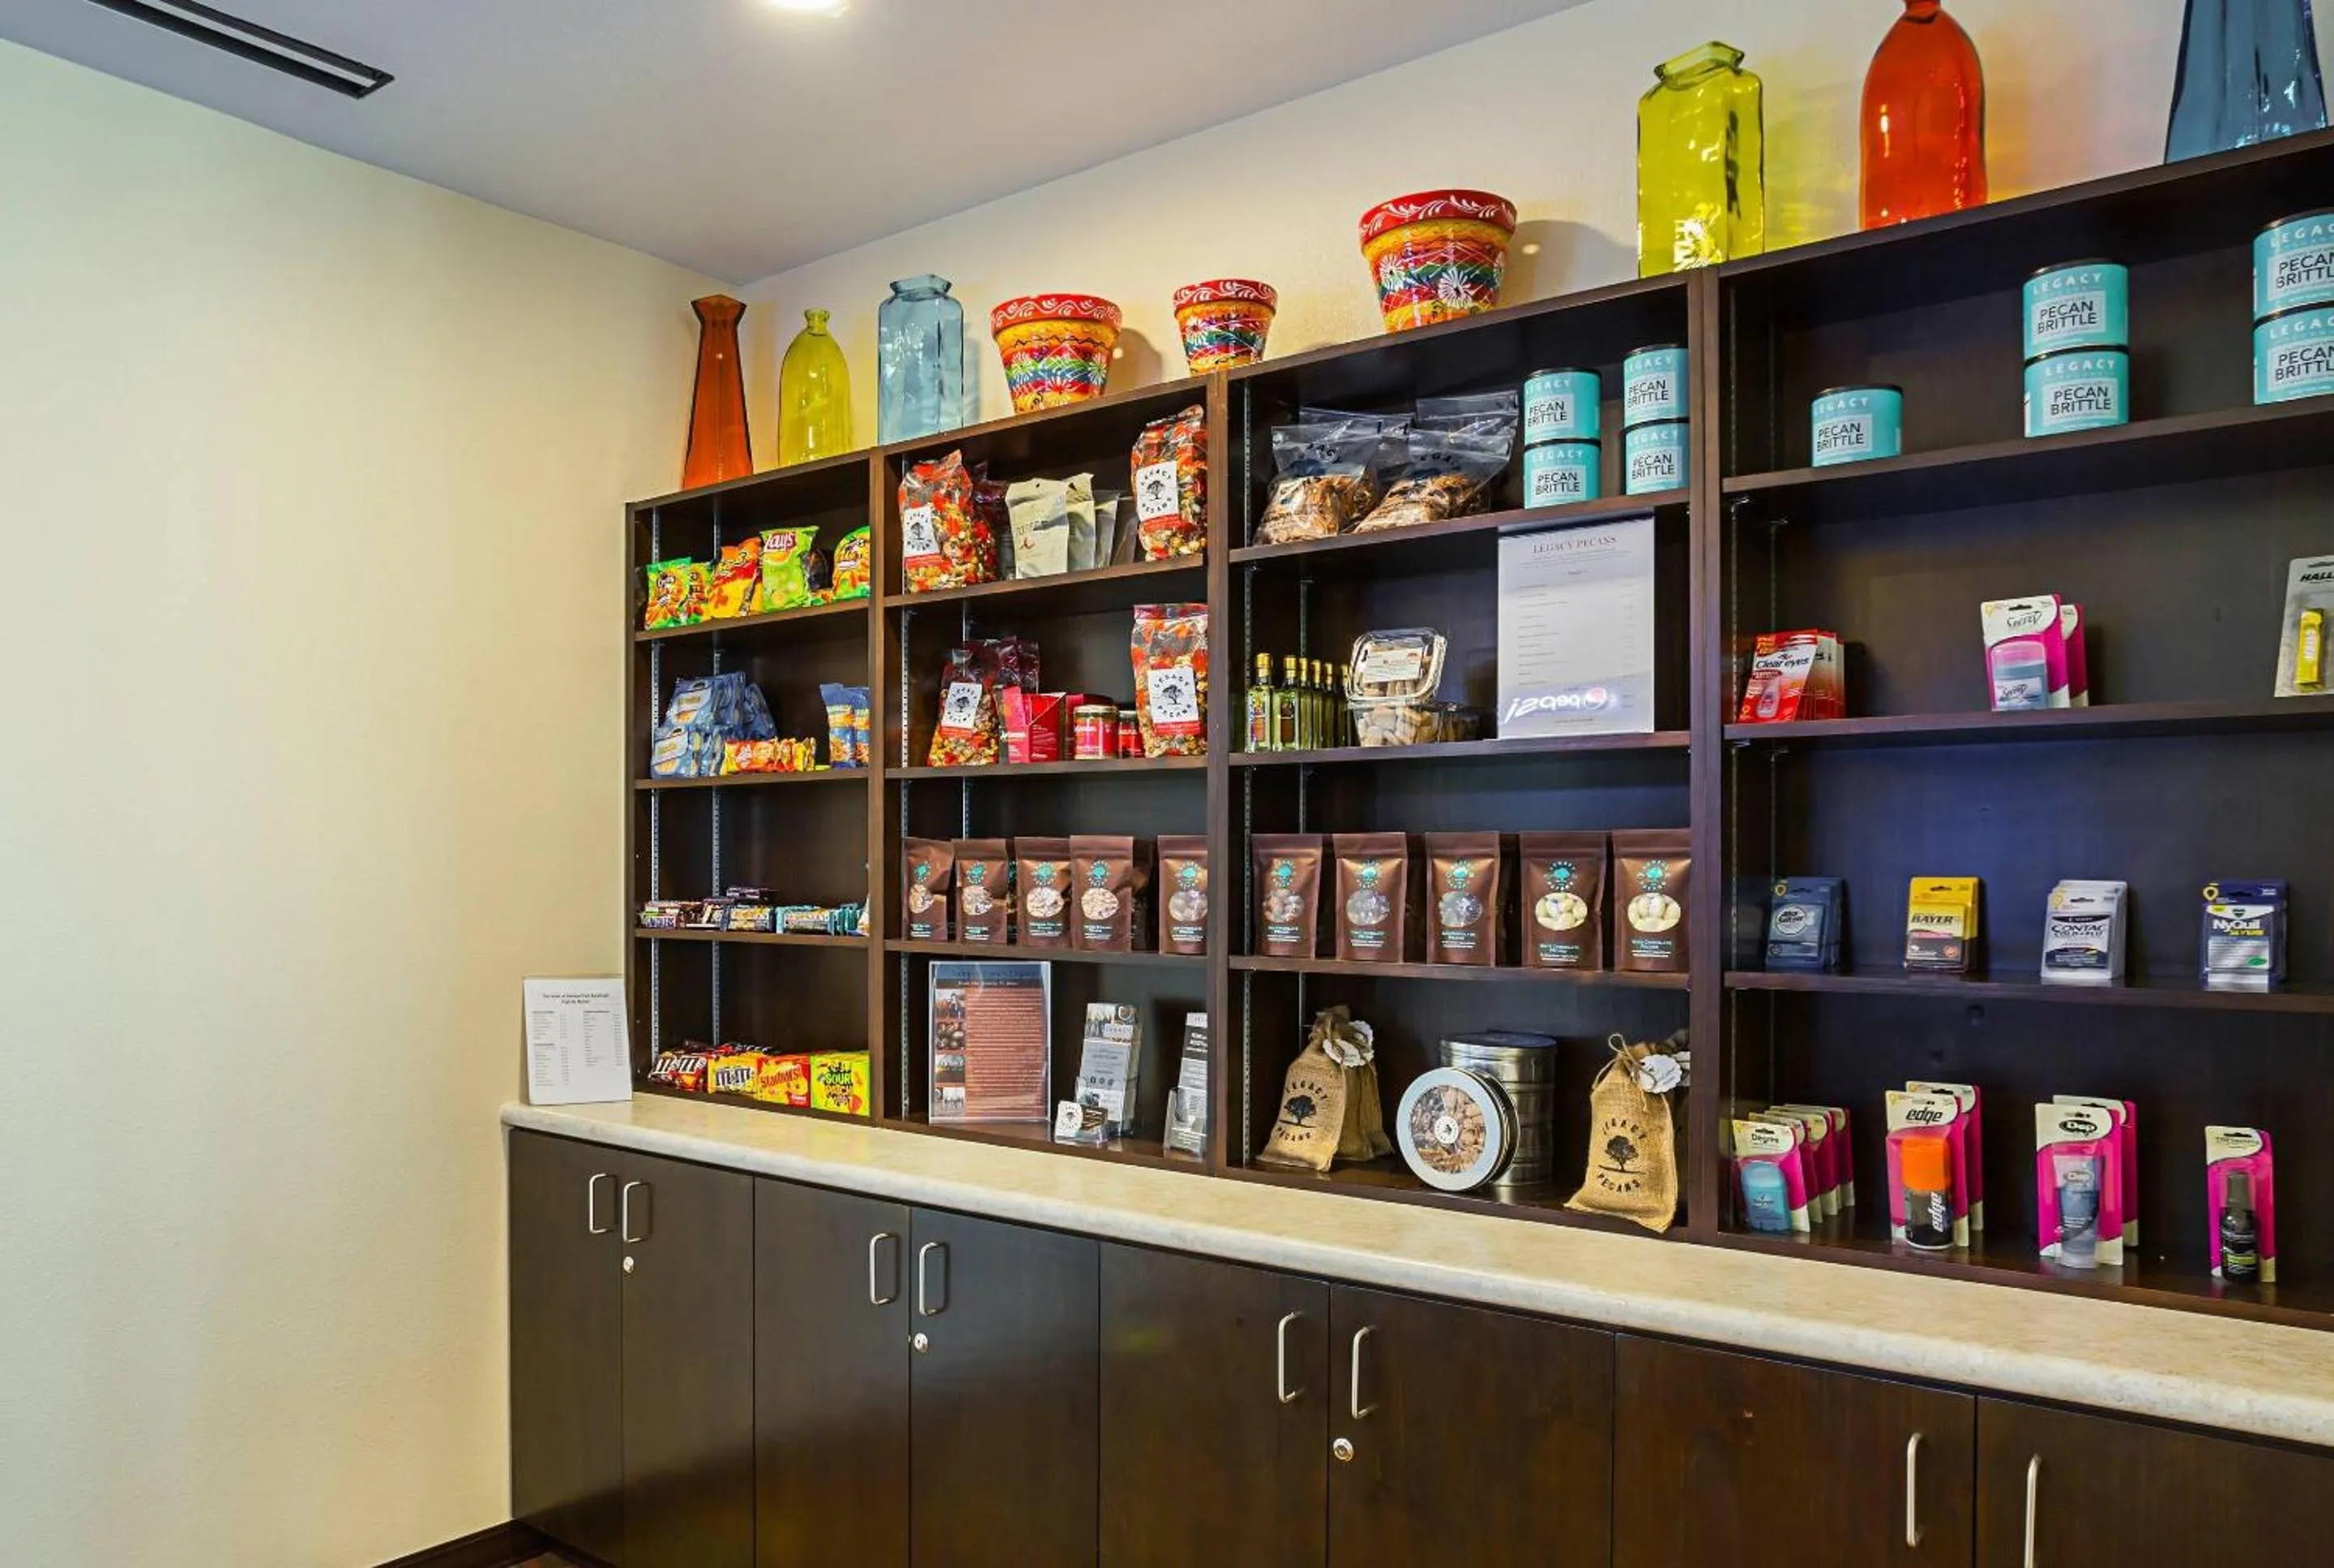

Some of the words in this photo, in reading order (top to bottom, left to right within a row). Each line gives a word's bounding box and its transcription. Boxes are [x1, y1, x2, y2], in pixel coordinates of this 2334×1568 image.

[2270, 224, 2334, 248] LEGAC
[2276, 266, 2334, 288] BRITTL
[2040, 301, 2094, 319] PECAN
[2037, 312, 2097, 334] BRITTLE
[2270, 316, 2334, 339] LEGAC
[2275, 359, 2334, 381] BRITTL
[1628, 379, 1666, 395] PECAN
[2053, 385, 2109, 402] PECAN
[1627, 390, 1669, 408] BRITTLE
[2050, 398, 2112, 416] BRITTLE
[1528, 401, 1566, 416] PECAN
[1527, 411, 1567, 428] BRITTLE
[1818, 423, 1861, 440] PECAN
[1817, 434, 1865, 452] BRITTLE
[1633, 453, 1673, 468] PECAN
[1537, 472, 1579, 484] PECAN
[1631, 465, 1676, 480] BRITTLE
[1535, 482, 1580, 496] BRITTLE
[2300, 571, 2334, 583] HALL
[1911, 913, 1954, 924] BAYER
[2212, 919, 2260, 933] NyQuil
[1905, 1105, 1943, 1125] edge
[1927, 1190, 1946, 1233] edge
